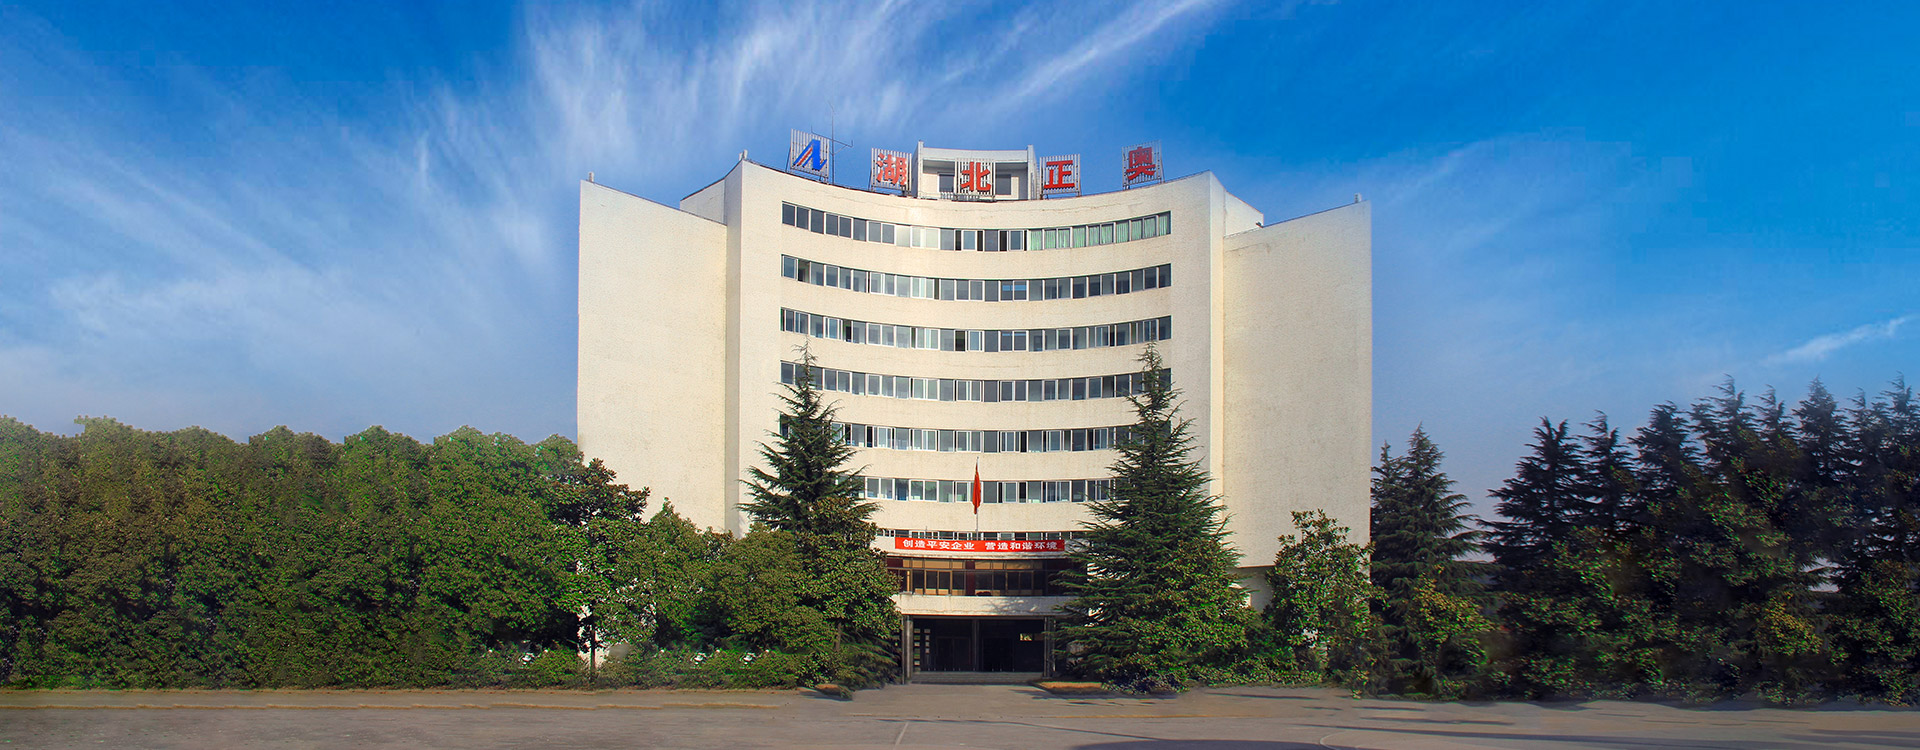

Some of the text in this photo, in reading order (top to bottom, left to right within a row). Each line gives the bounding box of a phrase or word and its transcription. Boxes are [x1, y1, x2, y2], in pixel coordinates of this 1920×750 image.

[876, 146, 1156, 192] 湖北正奥
[903, 539, 1058, 550] 创造平安企业 营造和谐环境
